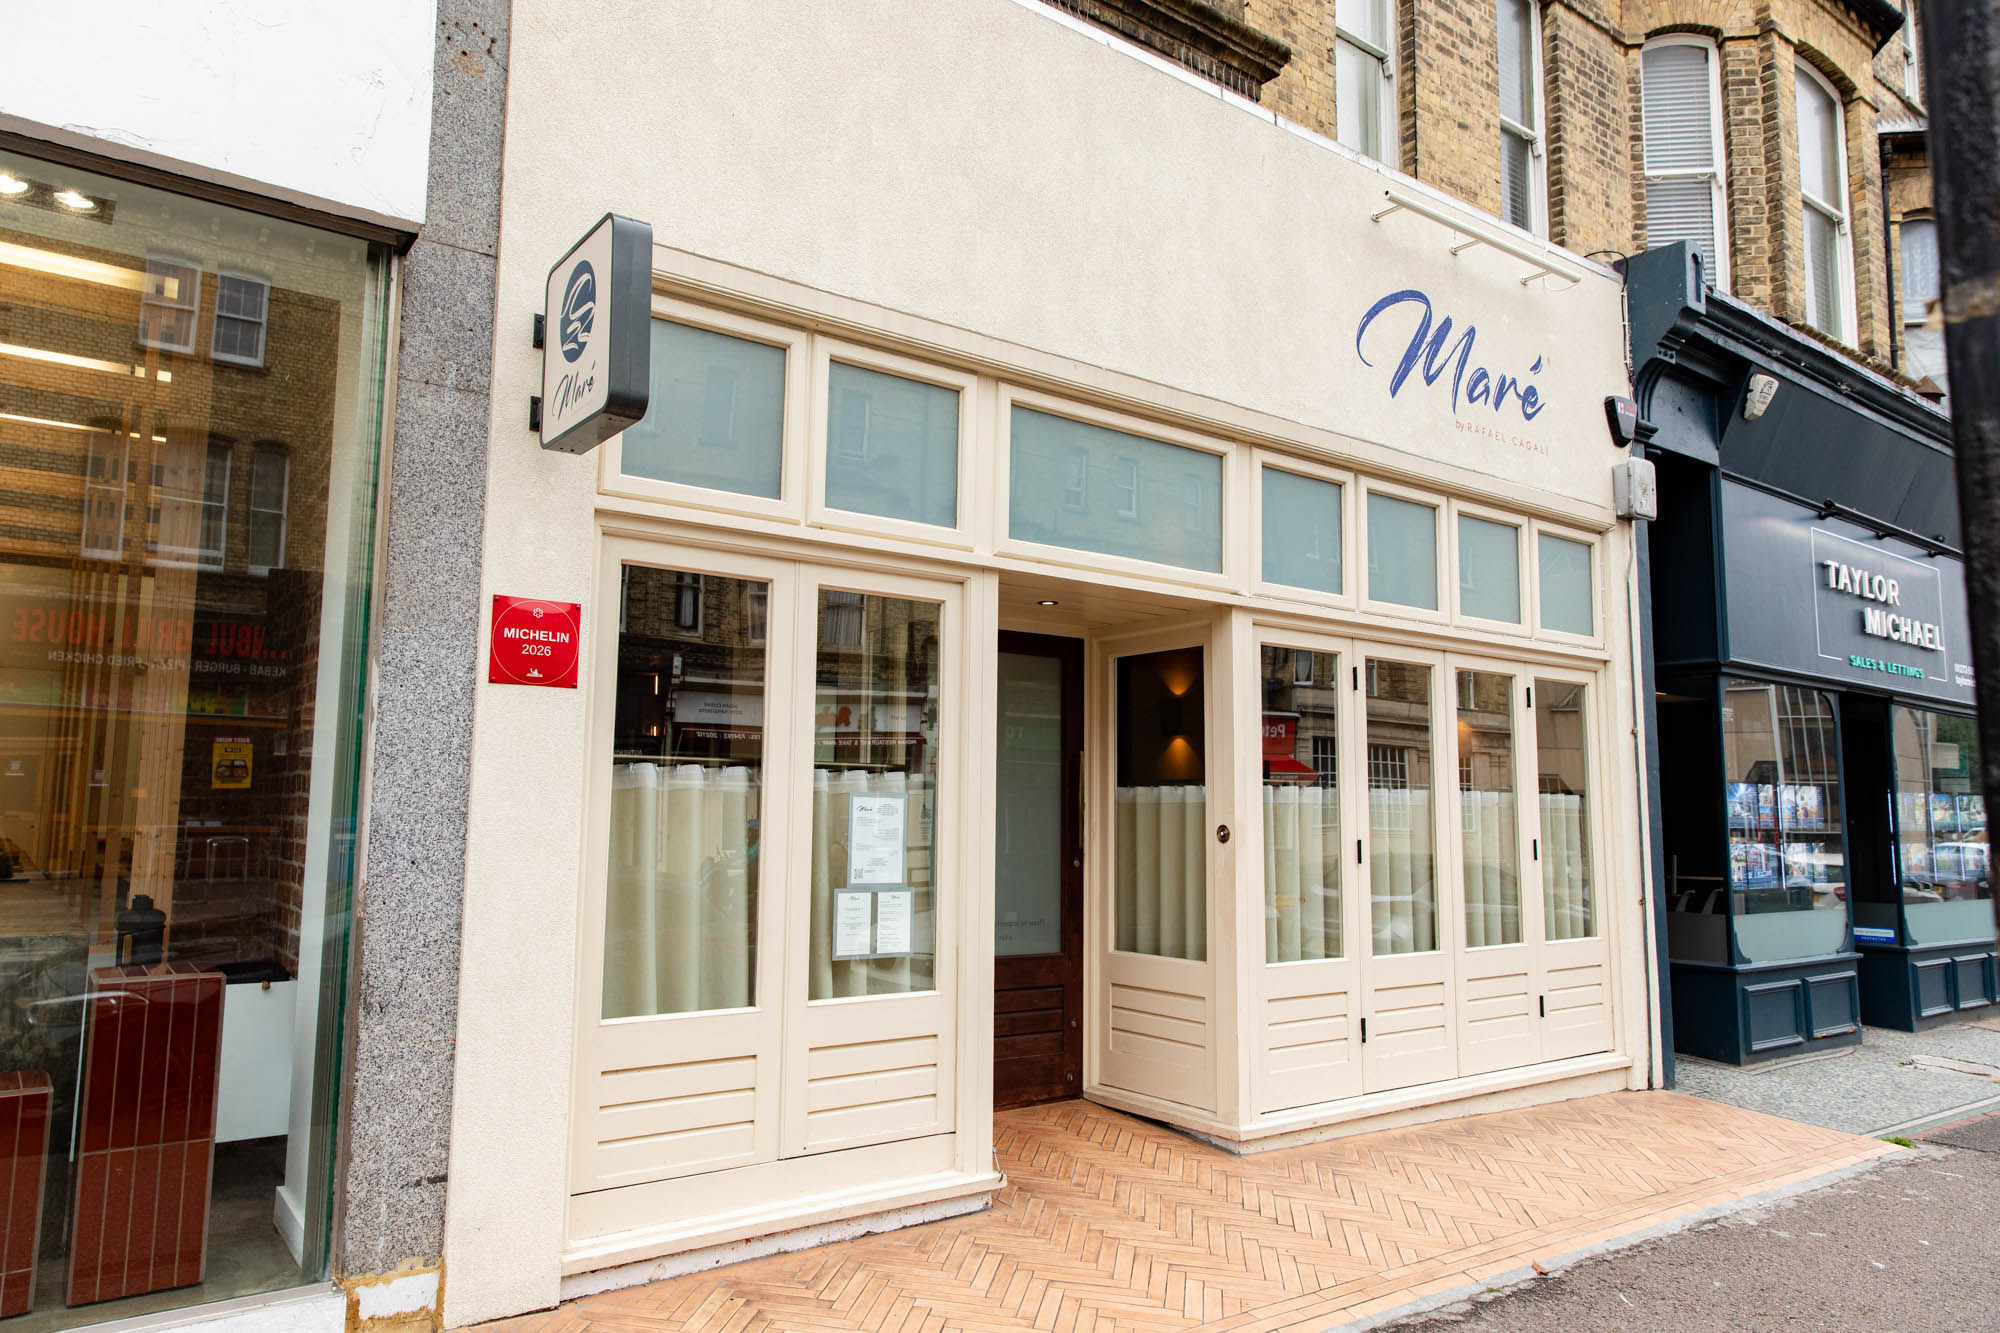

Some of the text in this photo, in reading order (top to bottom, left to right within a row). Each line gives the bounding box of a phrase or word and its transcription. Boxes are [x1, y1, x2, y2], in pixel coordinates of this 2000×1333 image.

[1357, 290, 1545, 421] Maré
[552, 360, 596, 421] Maré
[1456, 419, 1549, 456] by RAFAEL CAGALI
[1824, 560, 1900, 606] TAYLOR
[503, 626, 571, 644] MICHELIN
[1864, 607, 1945, 651] MICHAEL
[521, 644, 552, 657] 2026
[1849, 656, 1925, 679] SALES & LETTINGS
